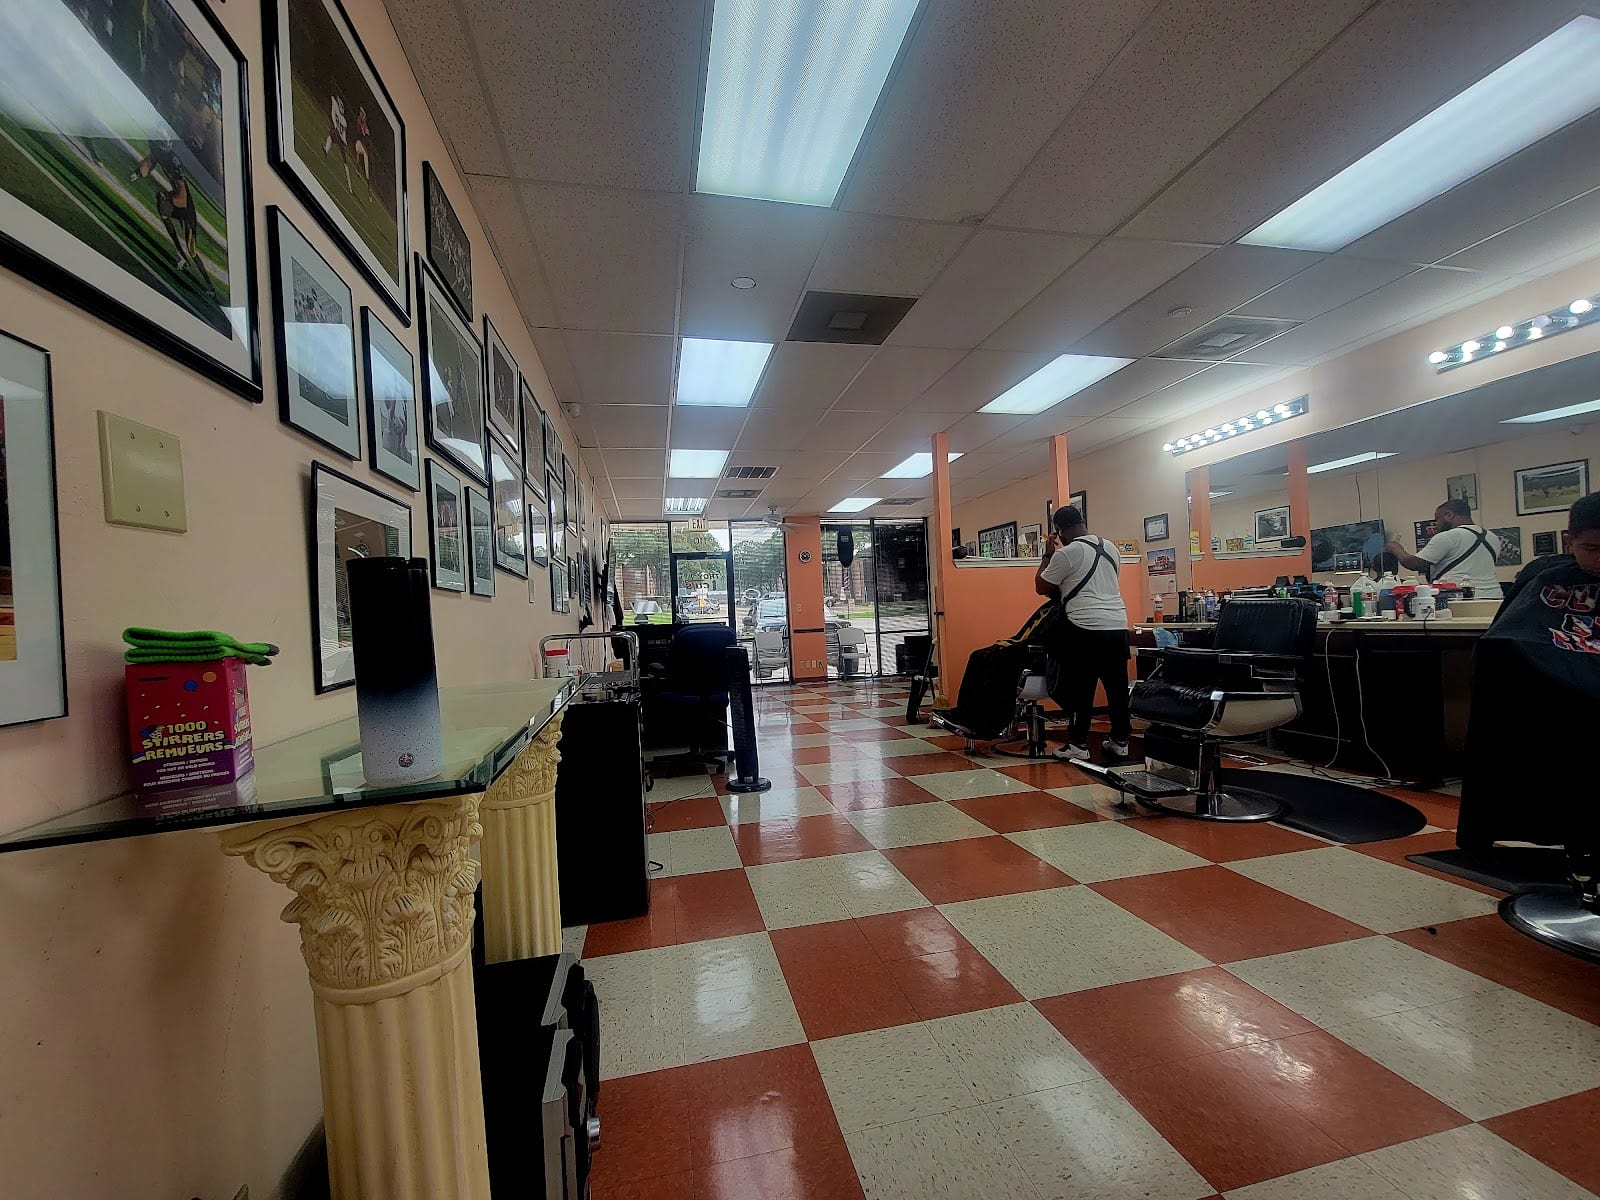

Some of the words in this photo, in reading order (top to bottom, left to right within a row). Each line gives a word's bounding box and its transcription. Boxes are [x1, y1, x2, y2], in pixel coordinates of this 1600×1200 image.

[692, 518, 706, 529] EXIT
[167, 721, 207, 733] 1000
[143, 730, 225, 749] STIRRERS
[145, 741, 224, 760] REMUEURS
